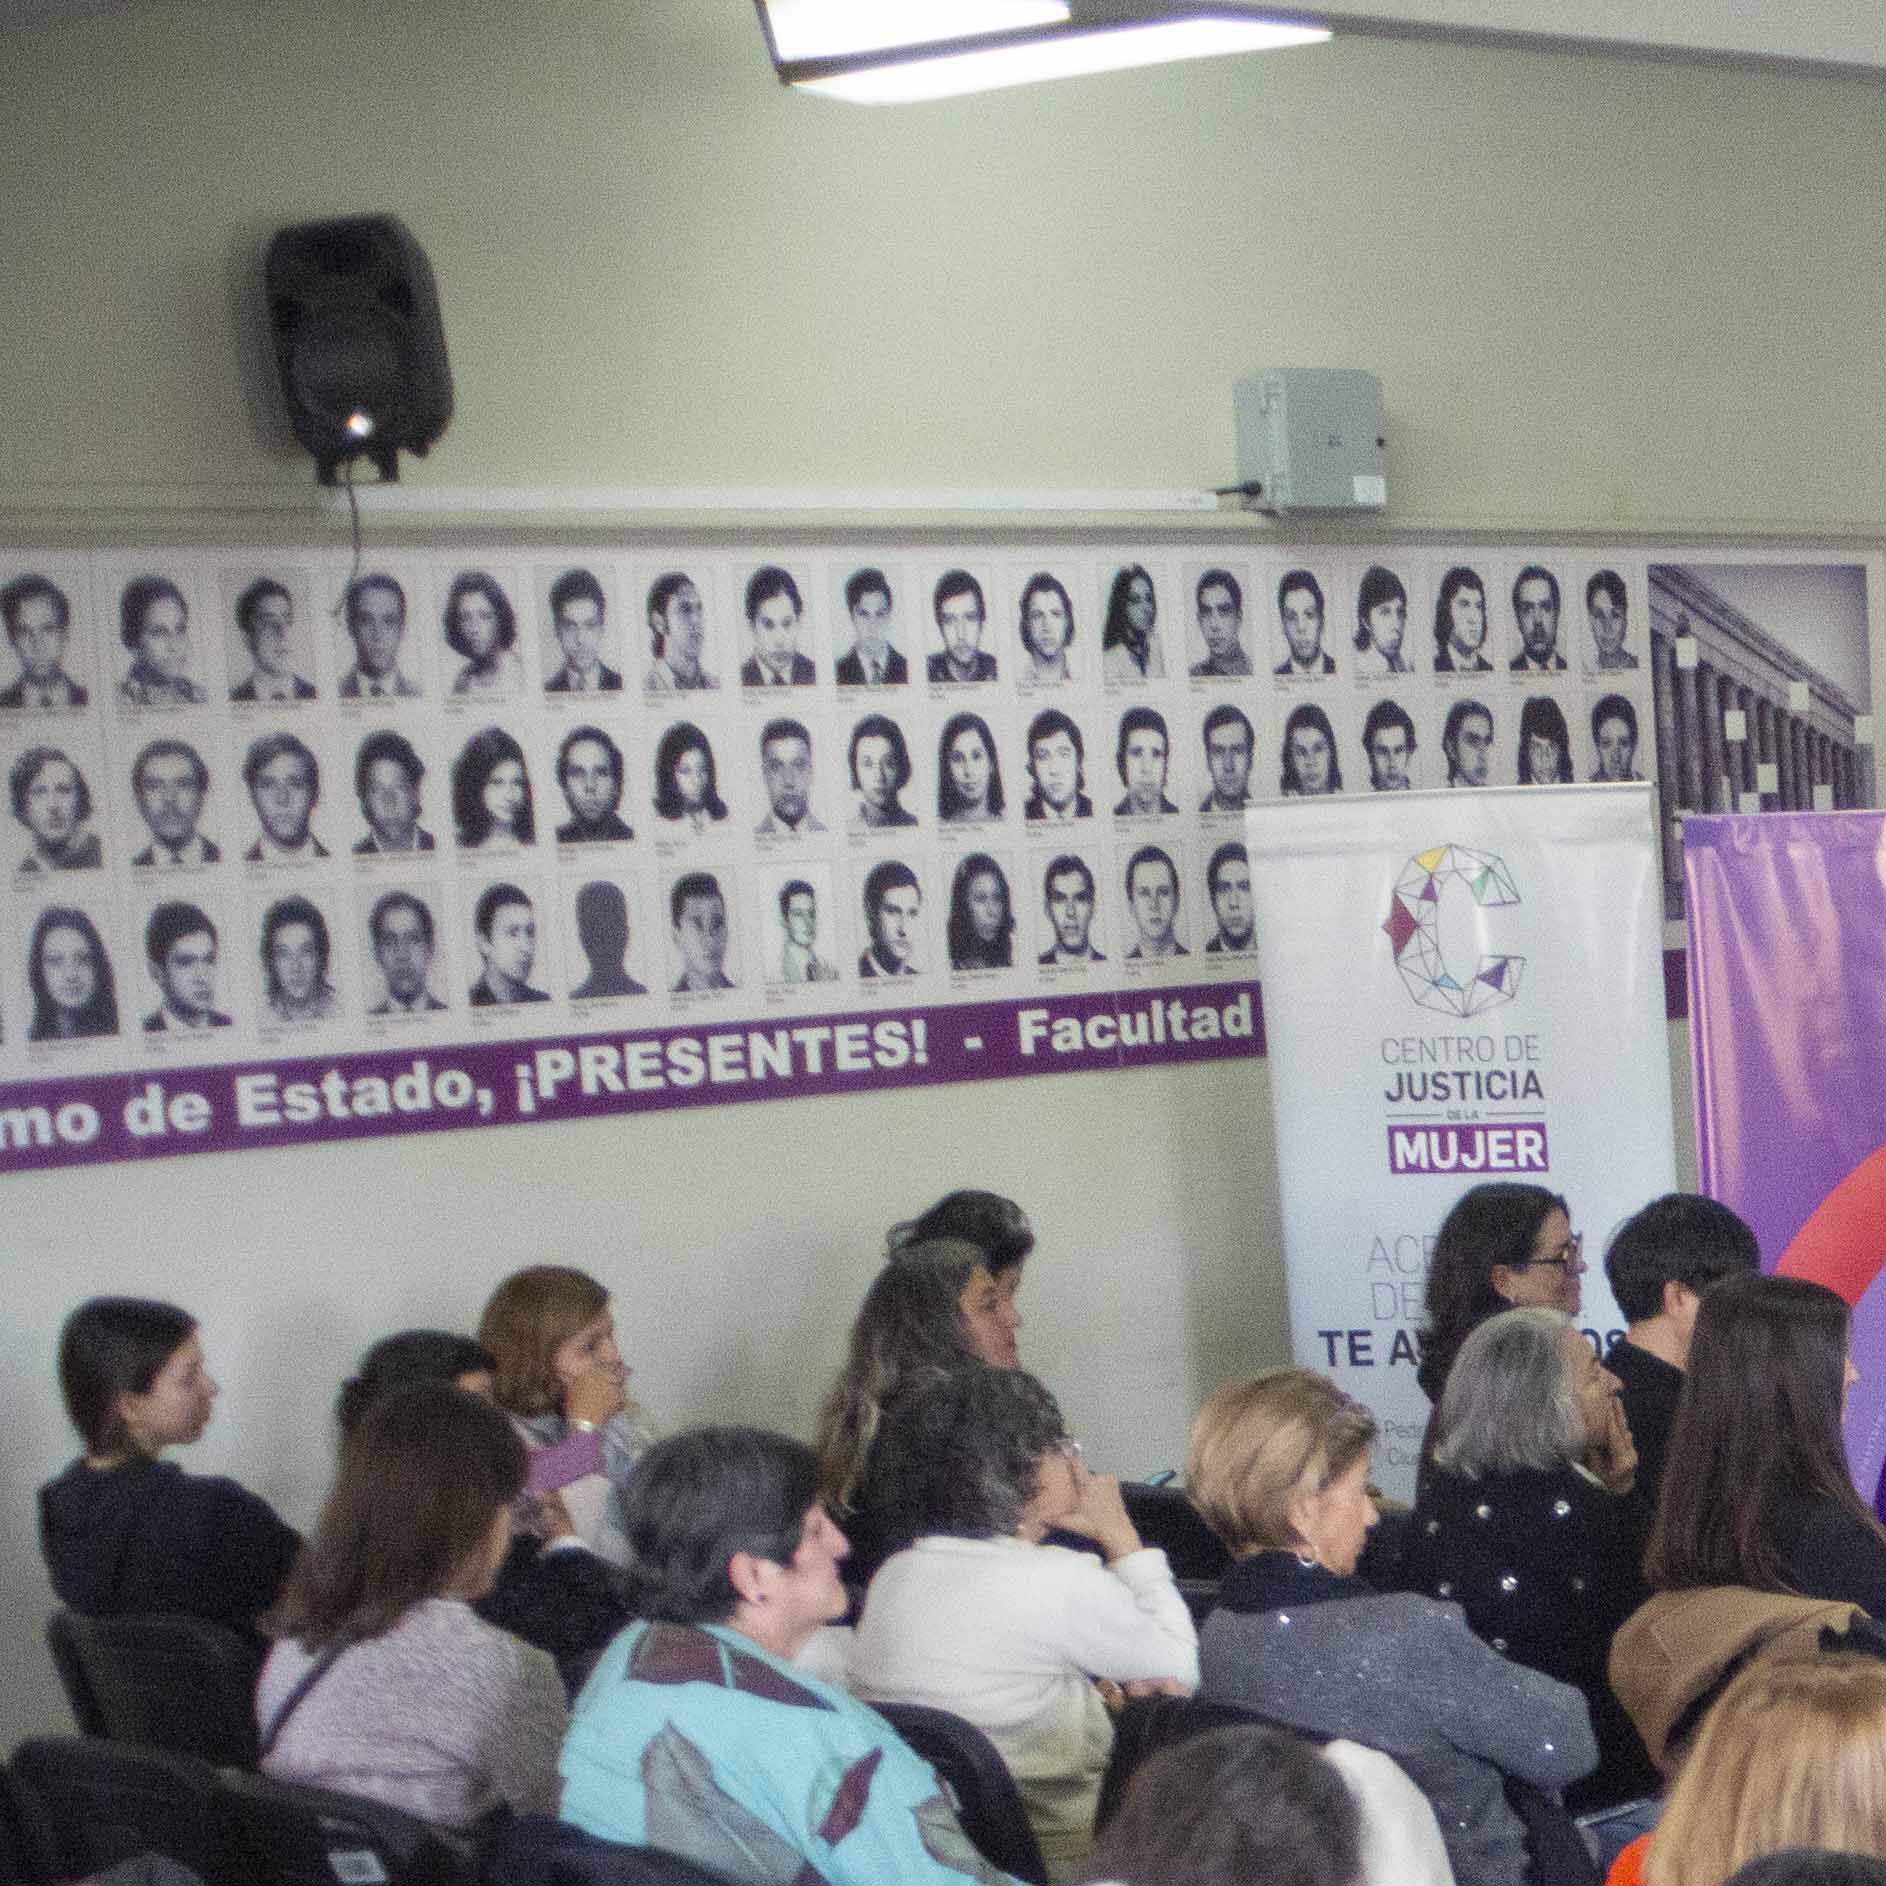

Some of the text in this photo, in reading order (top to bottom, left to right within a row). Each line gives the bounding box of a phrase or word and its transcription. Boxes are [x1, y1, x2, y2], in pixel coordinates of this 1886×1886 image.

[124, 1082, 213, 1137] de
[234, 1061, 494, 1127] Estado,
[516, 1020, 929, 1112] ¡PRESENTES!
[1017, 993, 1253, 1055] Facultad
[1381, 1034, 1542, 1065] CENTRO DE
[1385, 1069, 1545, 1102] JUSTICIA
[1393, 1129, 1547, 1170] MUJER
[1317, 1329, 1375, 1367] TE
